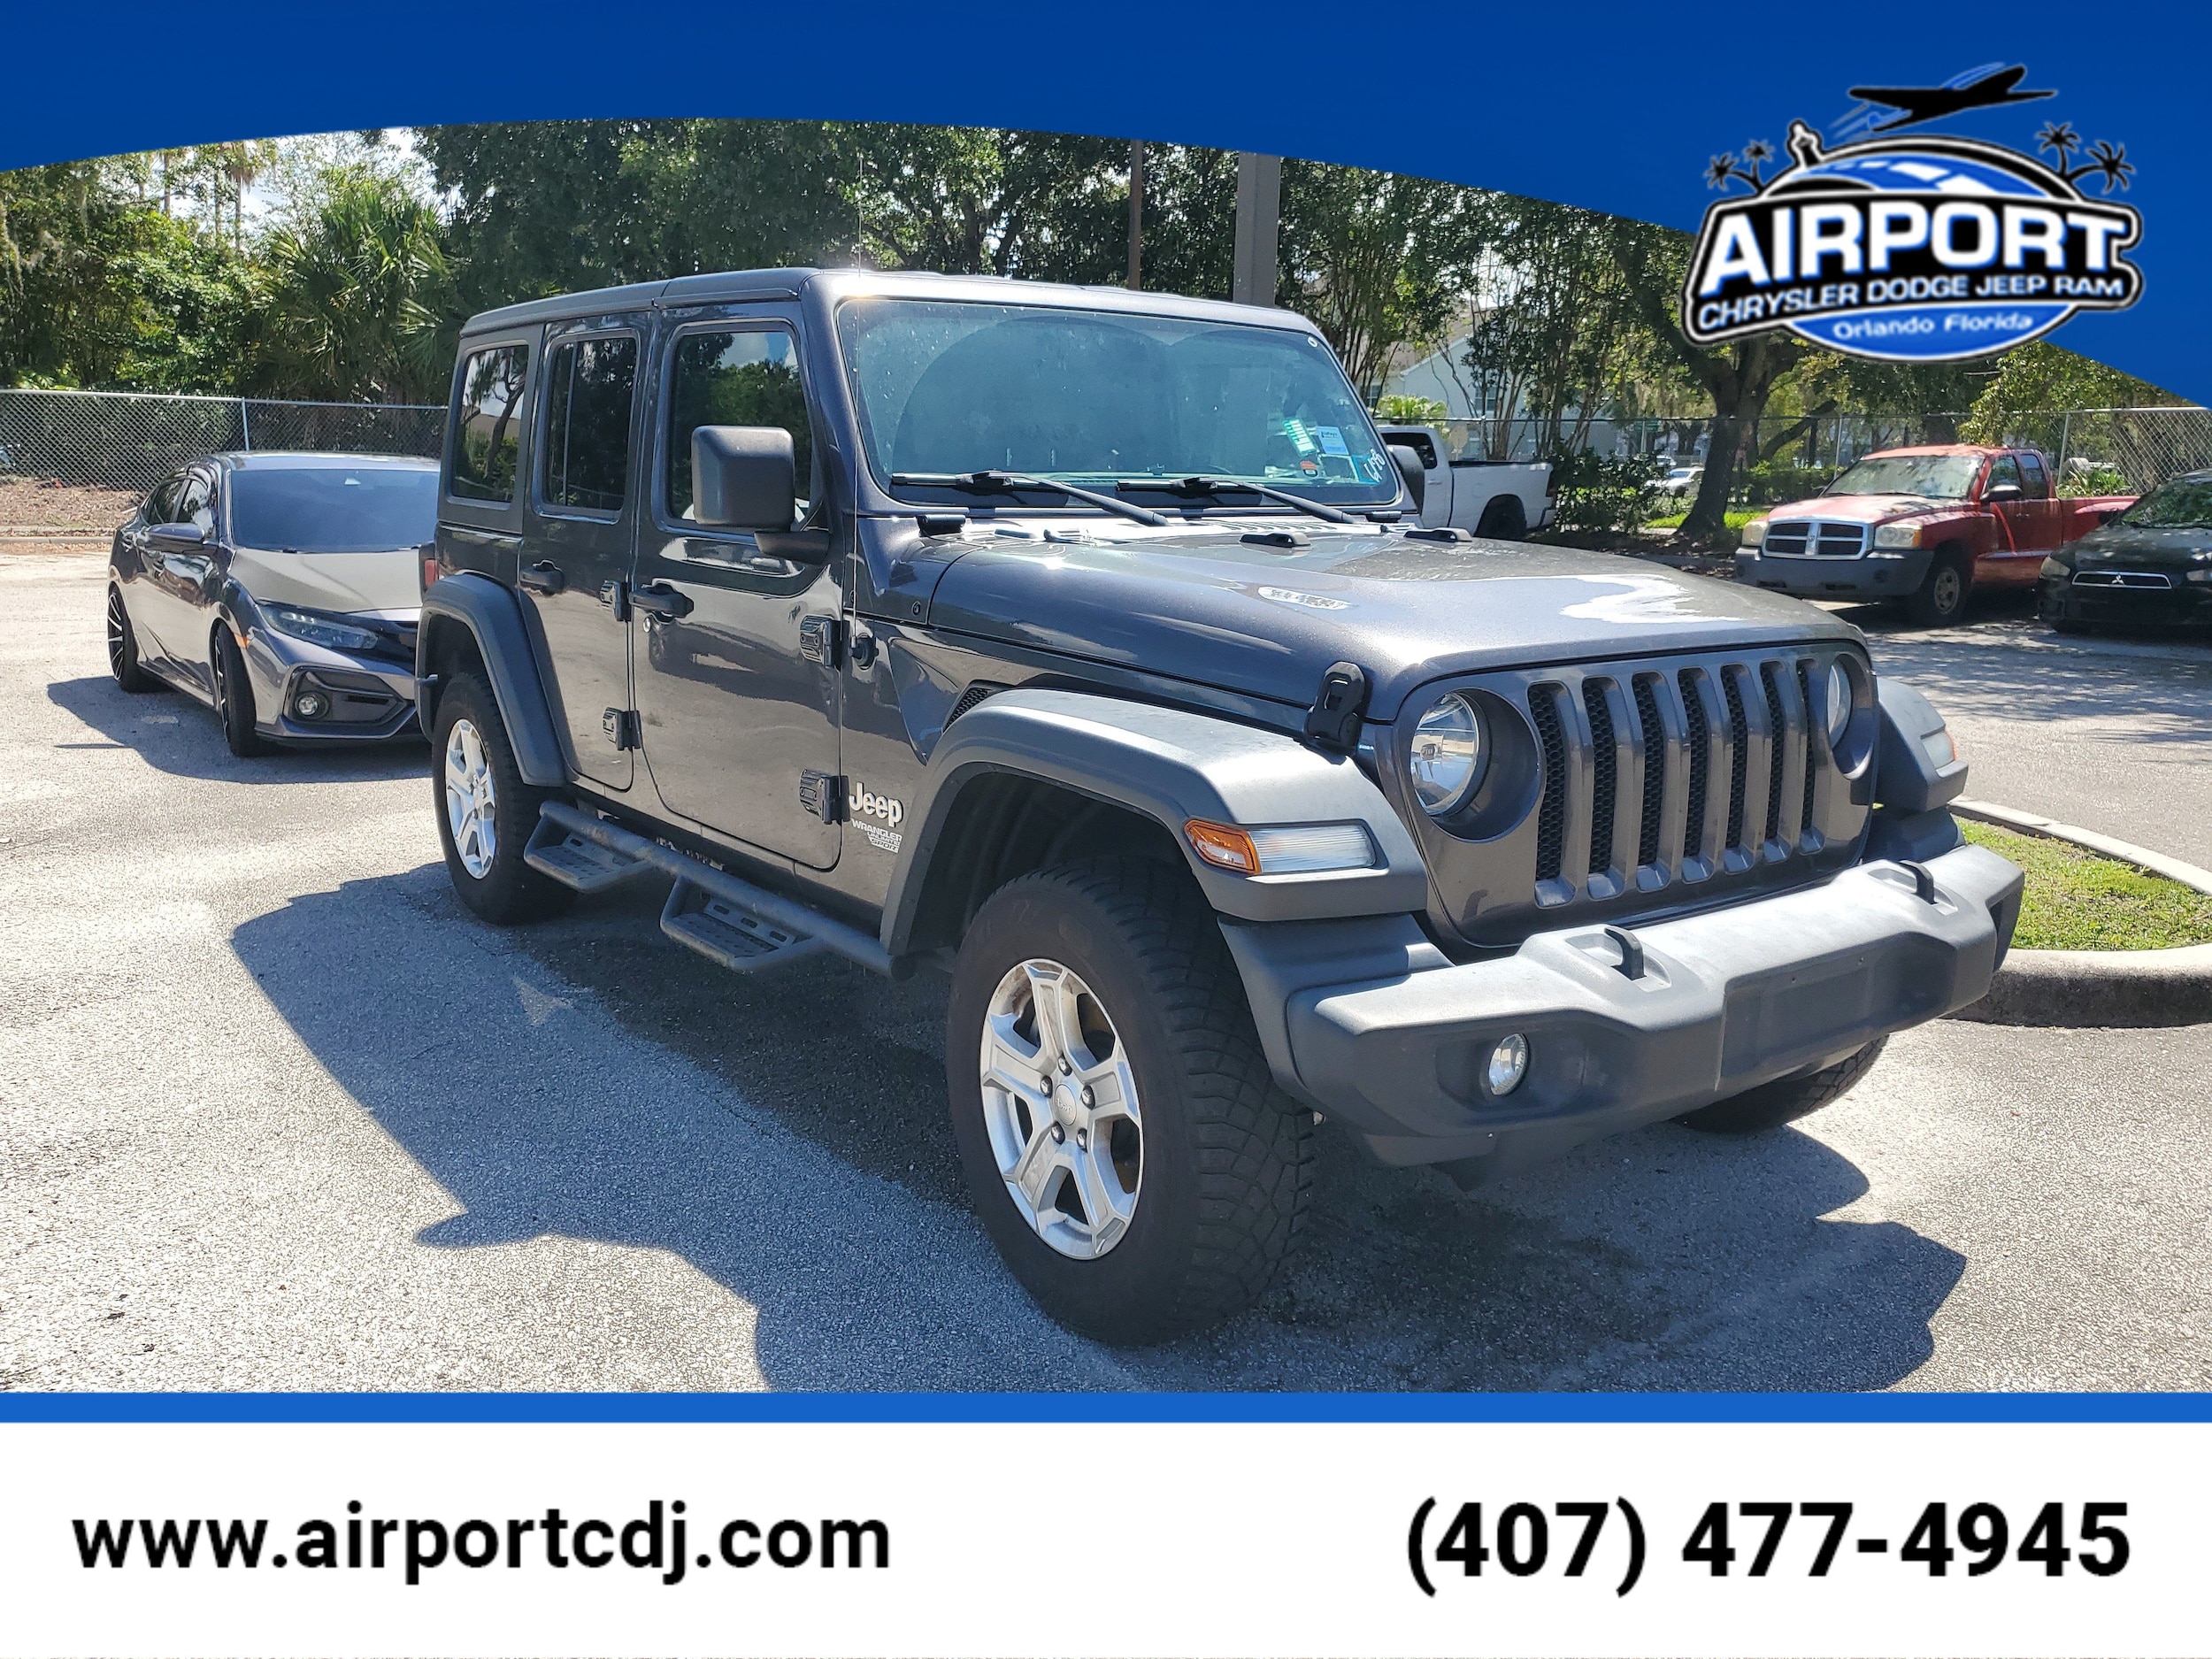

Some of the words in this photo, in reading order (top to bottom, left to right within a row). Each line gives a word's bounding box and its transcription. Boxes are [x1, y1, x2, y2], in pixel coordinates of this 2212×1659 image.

[849, 781, 903, 828] Jeep
[850, 818, 902, 842] WRANGLER
[870, 837, 899, 853] SPOR
